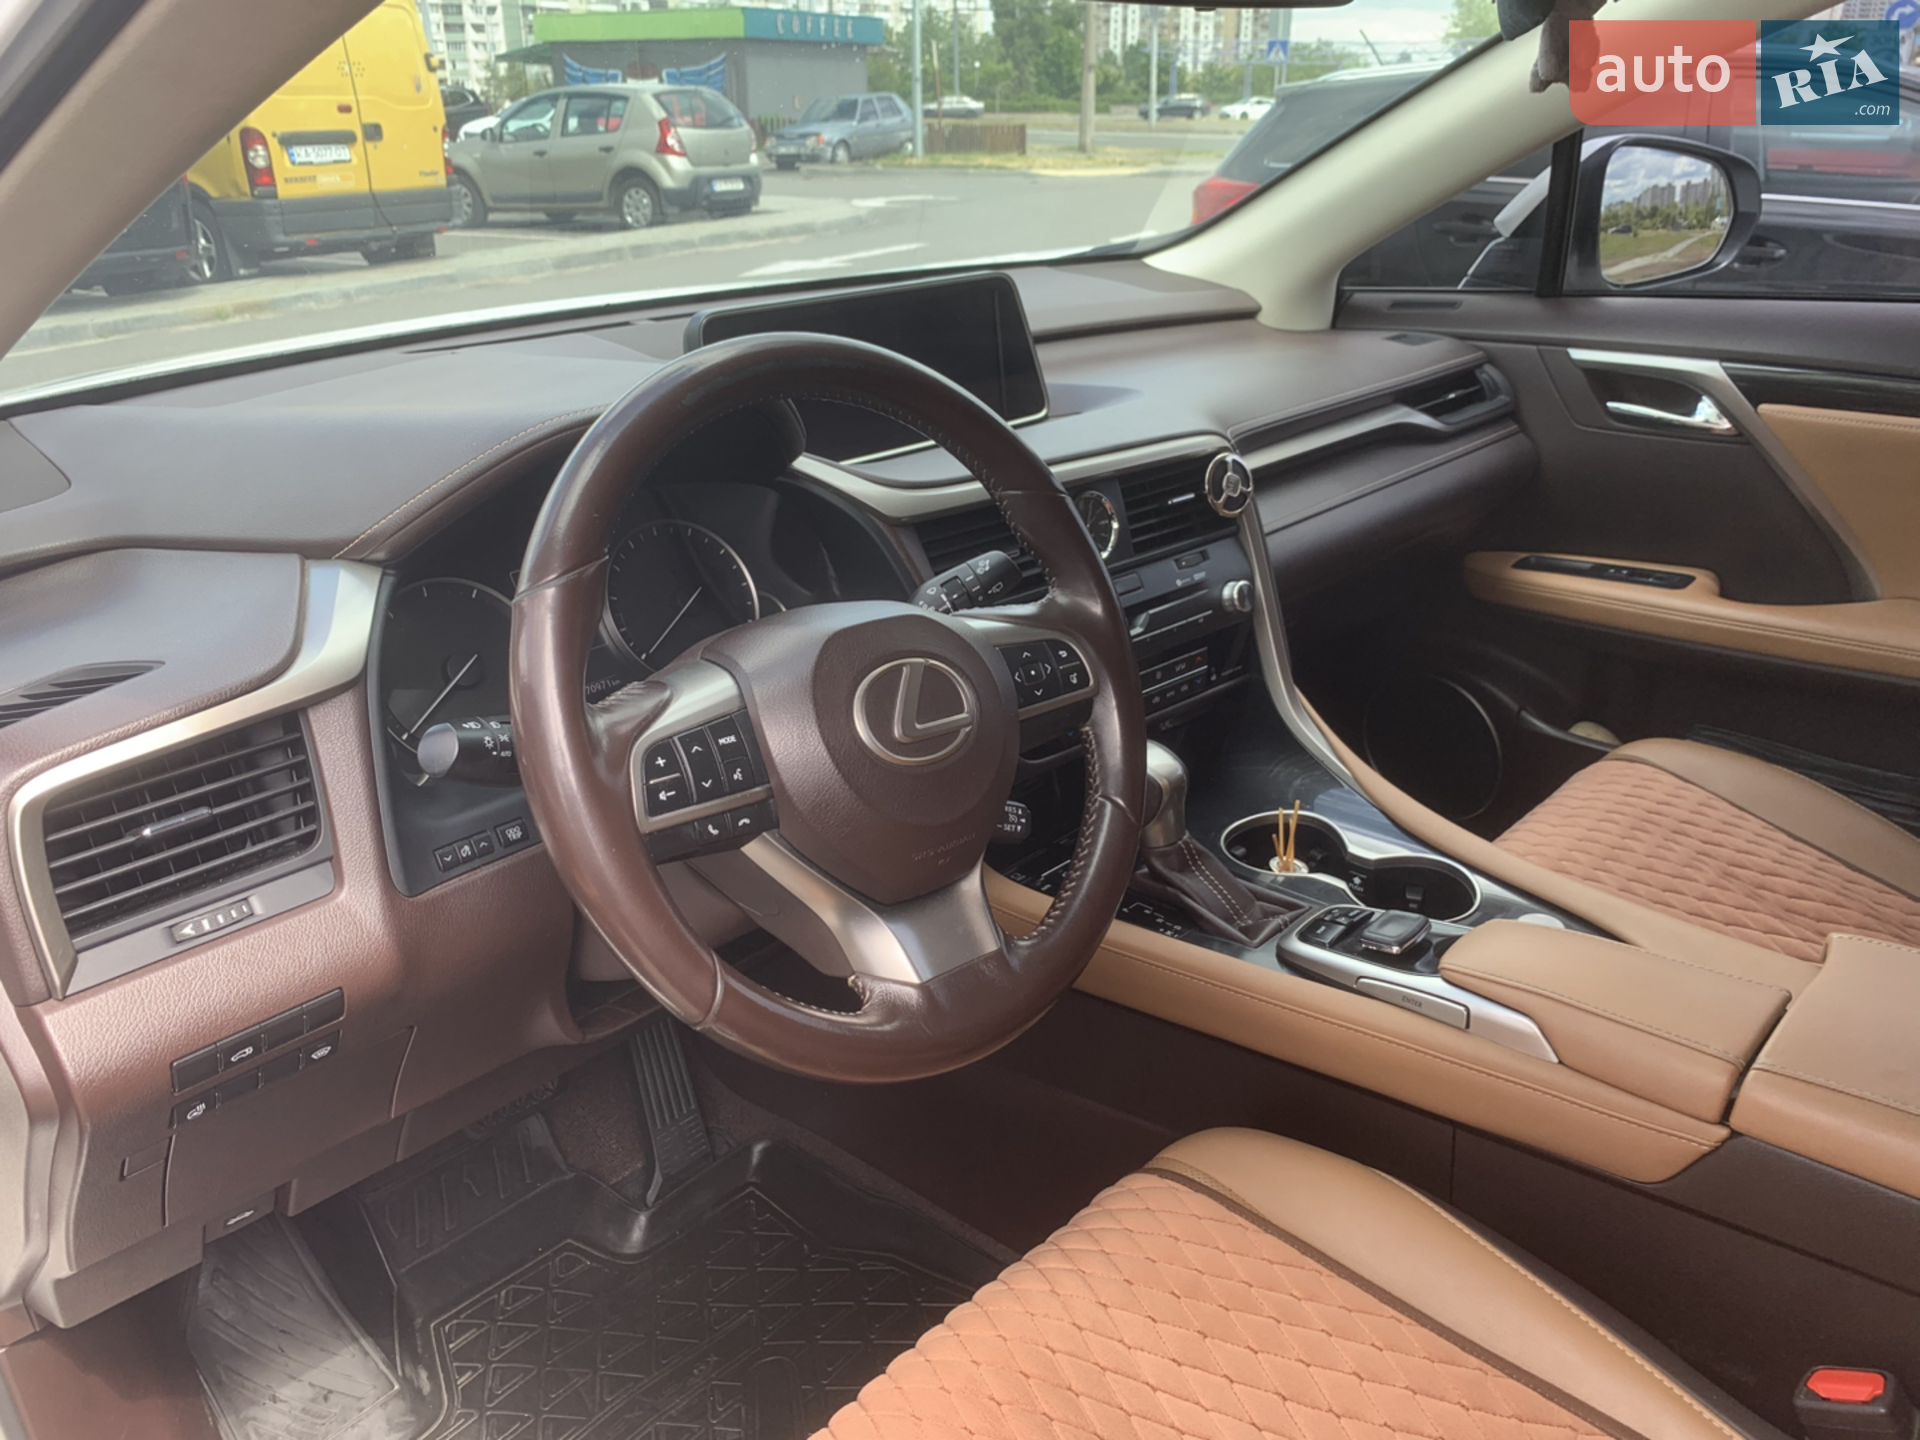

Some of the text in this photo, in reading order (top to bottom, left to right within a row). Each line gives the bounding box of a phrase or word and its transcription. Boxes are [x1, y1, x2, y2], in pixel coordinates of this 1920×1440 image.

[776, 12, 854, 39] COFFEE
[718, 734, 737, 746] MODE
[1402, 995, 1423, 1008] ENTER
